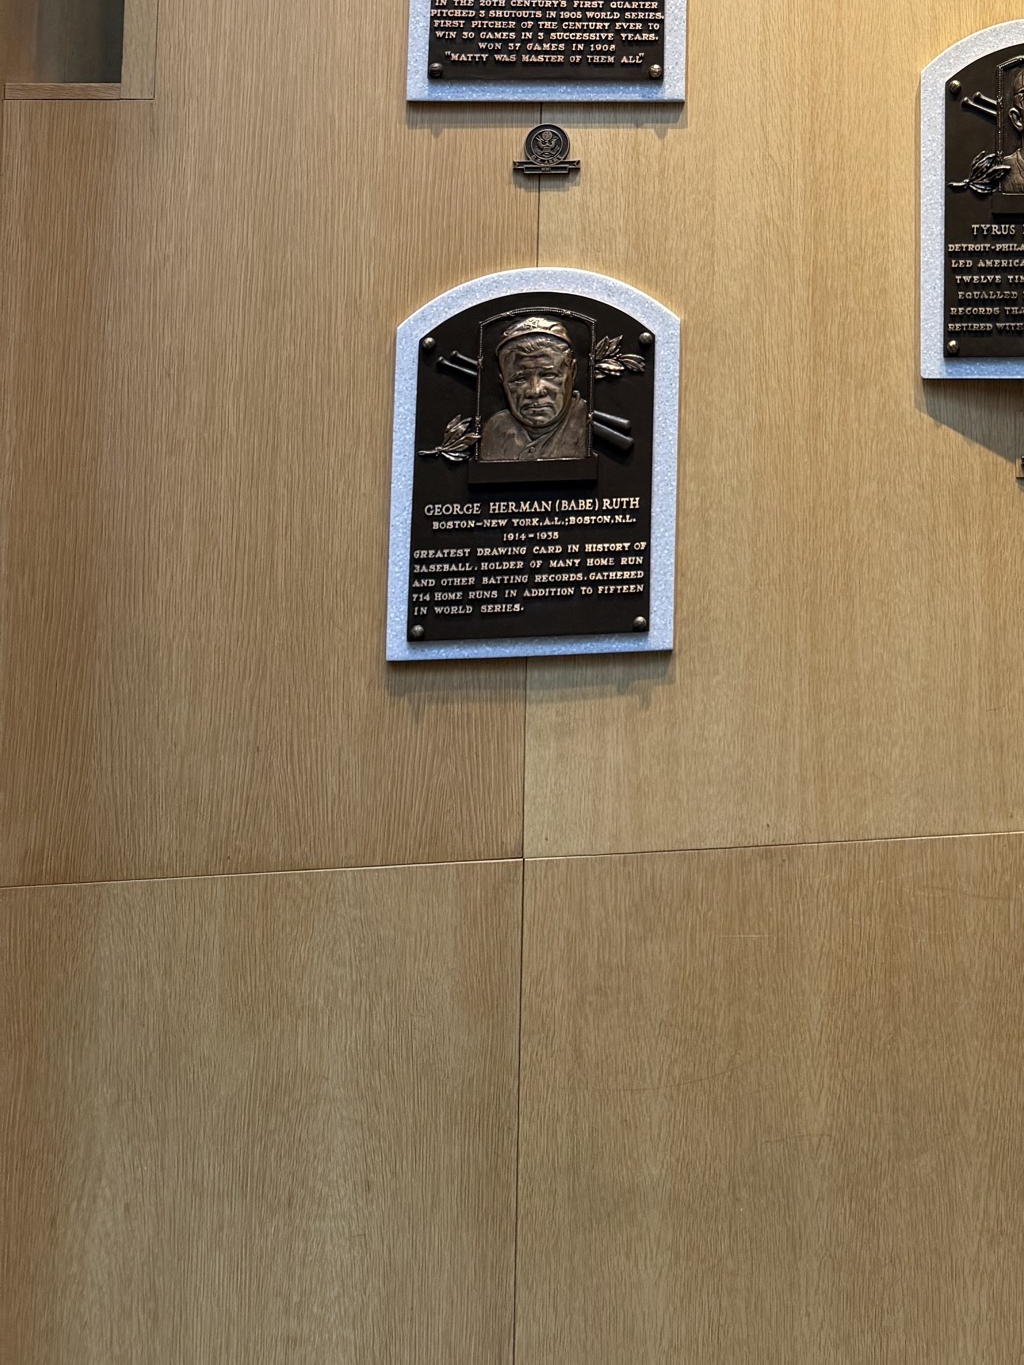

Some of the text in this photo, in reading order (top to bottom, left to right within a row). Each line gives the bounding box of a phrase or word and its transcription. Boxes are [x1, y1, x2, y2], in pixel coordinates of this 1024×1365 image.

[610, 1, 658, 9] QUARTER
[430, 9, 475, 17] PITCHED
[625, 12, 665, 20] SERIES.
[550, 32, 614, 40] SUCCESSIVE
[972, 224, 1015, 234] TYRUS
[956, 275, 1001, 283] TWELVE
[425, 497, 639, 515] GEORGE HERMAN (BABE) RUTH
[414, 549, 470, 558] GREATEST
[477, 547, 526, 556] DRAWING
[568, 544, 579, 552] IN
[585, 543, 630, 552] HISTORY
[634, 542, 646, 550] OF
[481, 561, 523, 570] HOLDER
[530, 560, 542, 568] OF
[550, 559, 580, 567] MANY
[587, 558, 614, 566] HOME
[621, 557, 643, 565] RUN
[412, 579, 435, 587] AND
[441, 577, 475, 585] OTHER
[482, 575, 528, 584] BATTING
[589, 571, 644, 580] GATHERED
[435, 592, 462, 600] HOME
[469, 591, 497, 599] RUNS
[524, 587, 574, 596] ADDITION
[581, 586, 592, 594] TO
[598, 585, 644, 593] FIFTEEN
[414, 604, 524, 615] IN WORLD SERIES.
